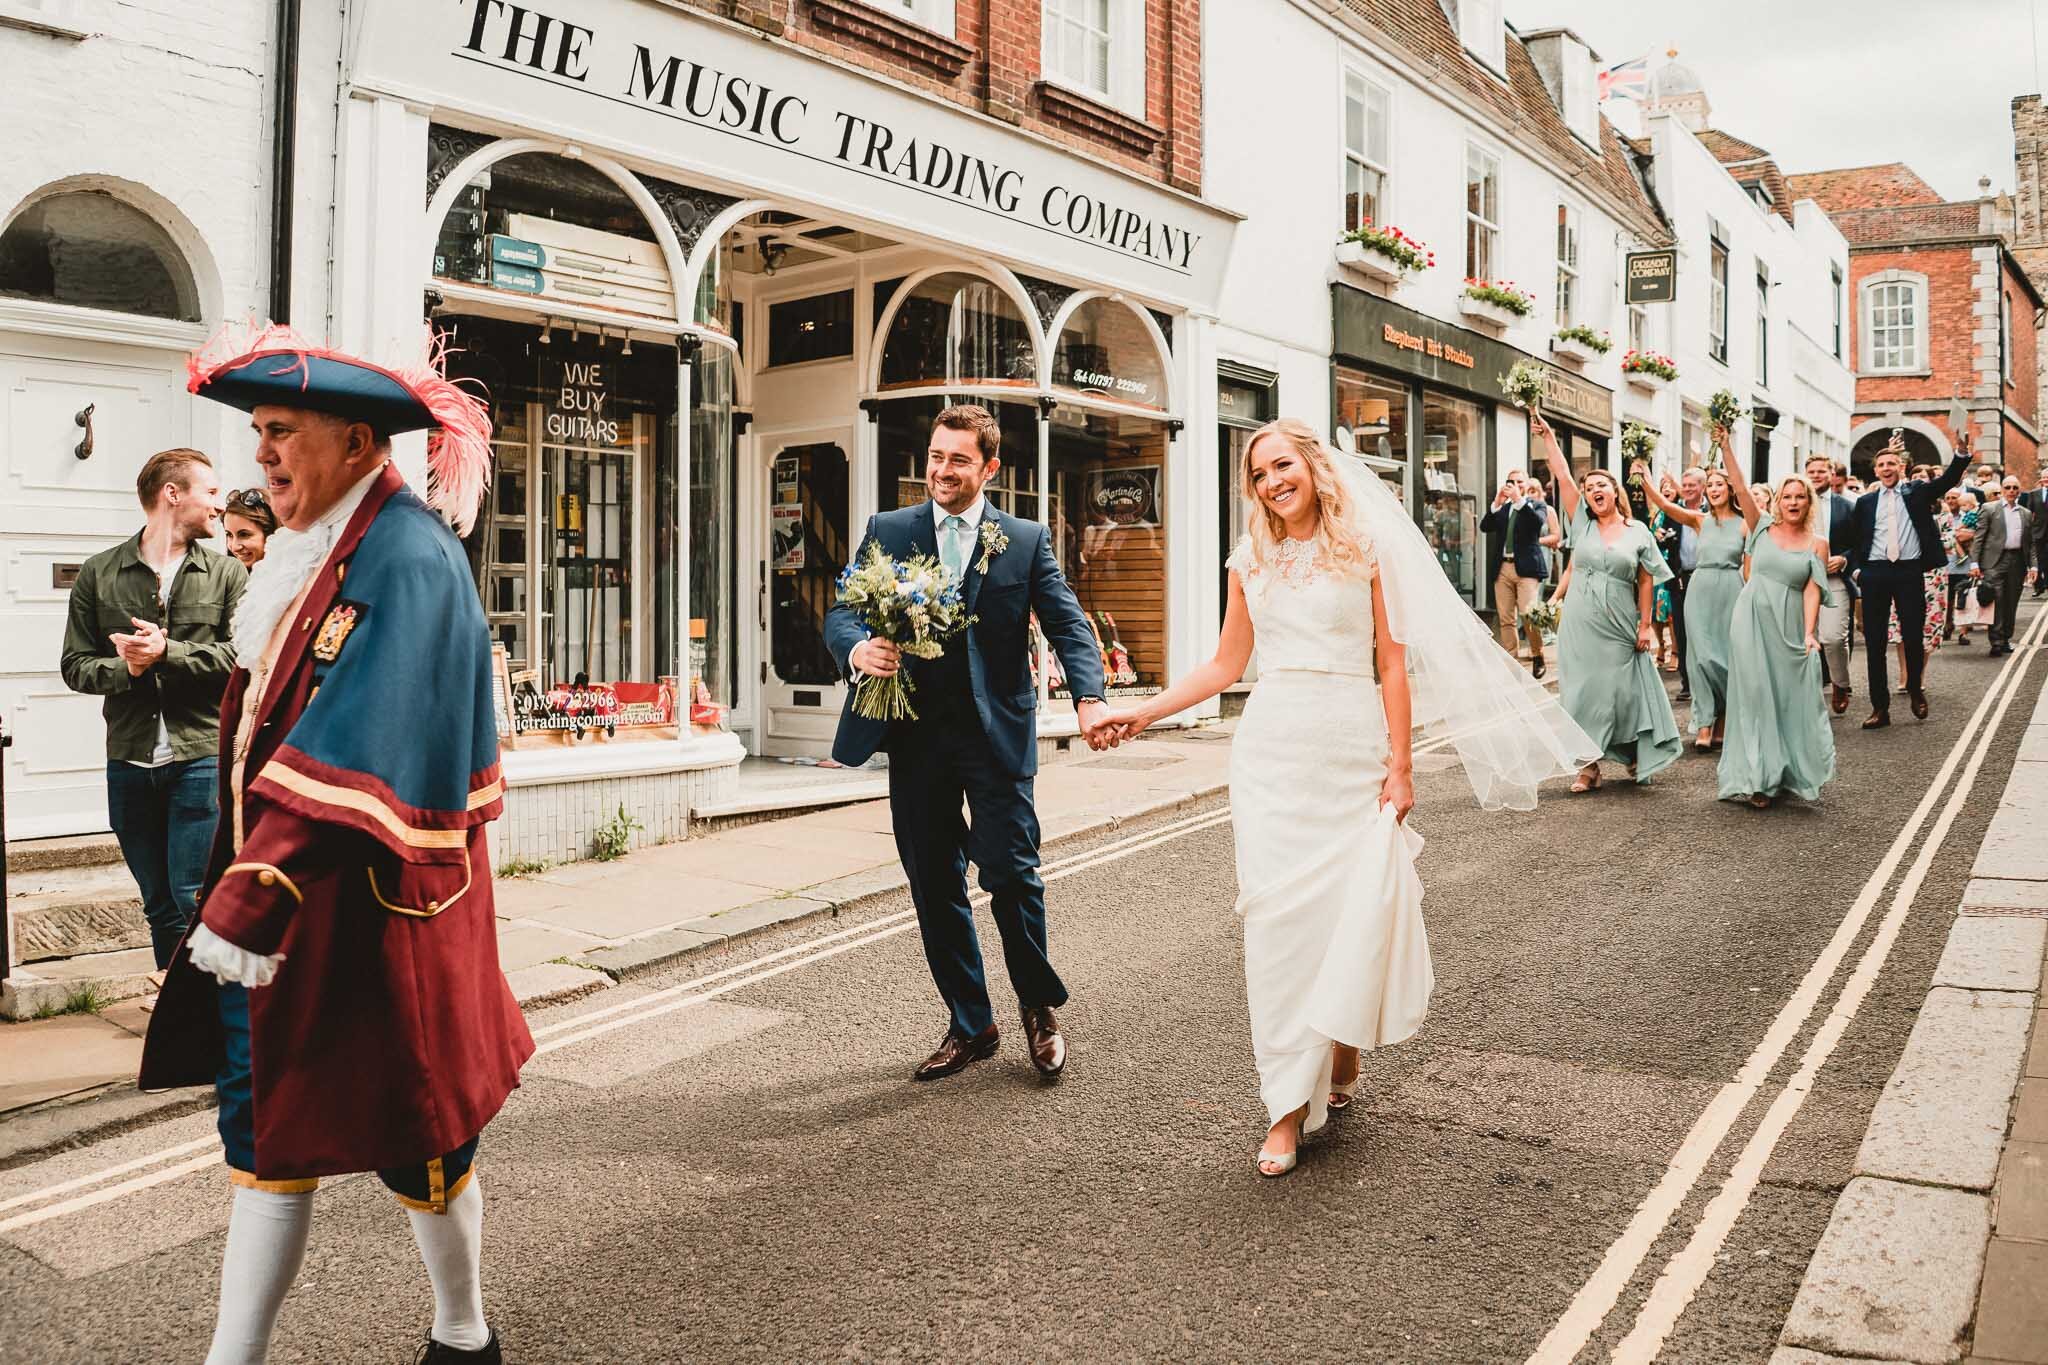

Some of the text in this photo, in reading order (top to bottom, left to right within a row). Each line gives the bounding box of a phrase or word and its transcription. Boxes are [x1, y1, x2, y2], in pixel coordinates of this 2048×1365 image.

[459, 0, 1202, 268] THE MUSIC TRADING COMPANY
[564, 361, 604, 387] WE
[1088, 372, 1114, 388] 01797
[561, 387, 607, 413] BUY
[547, 413, 619, 443] GUITARS
[1631, 491, 1644, 502] 22
